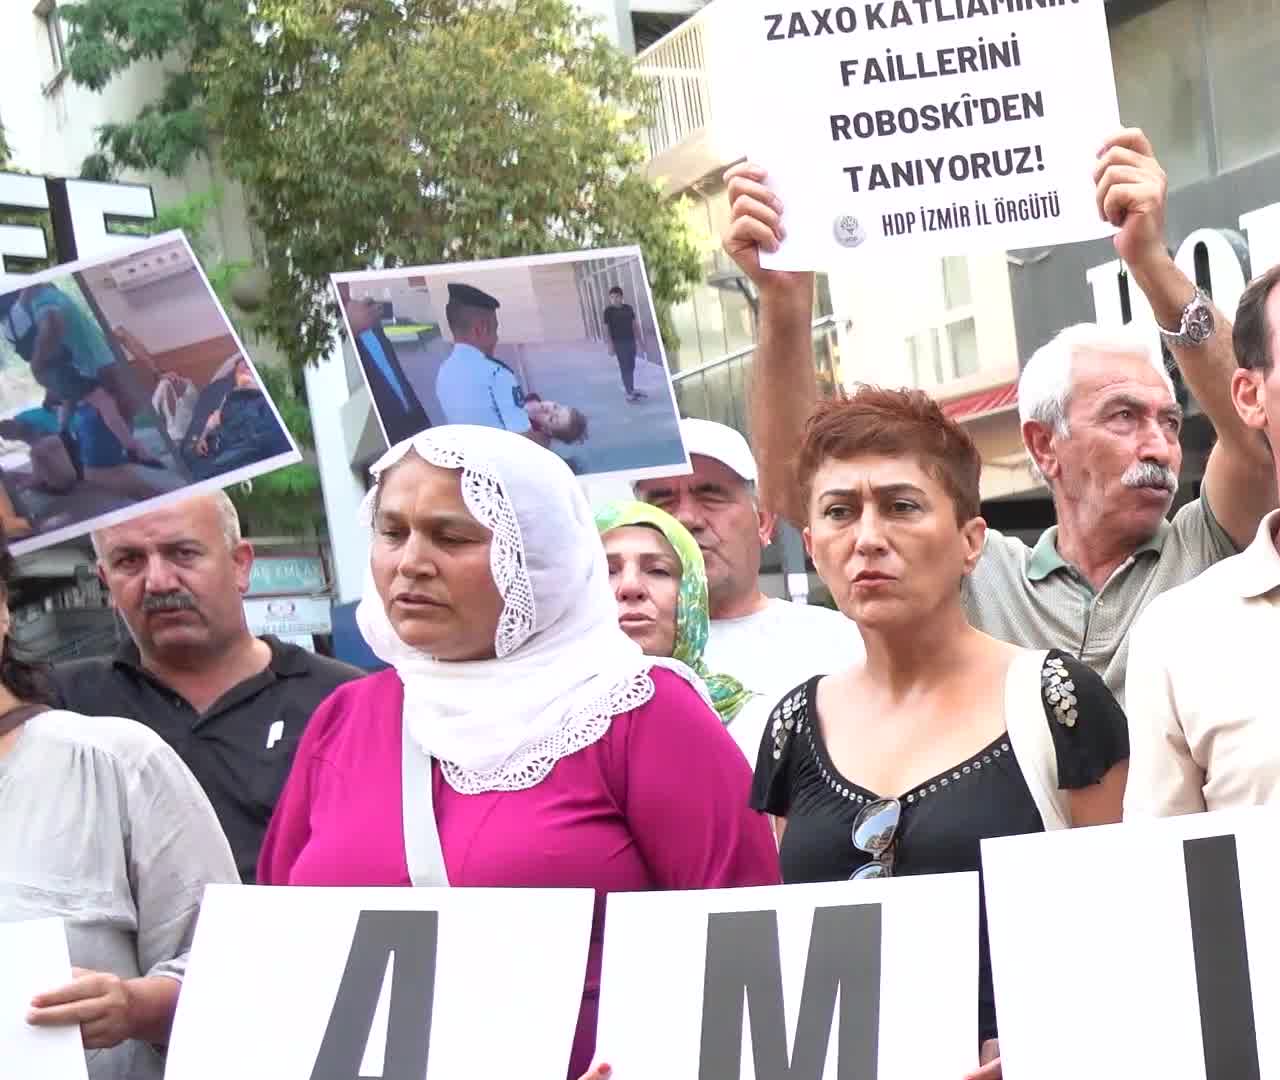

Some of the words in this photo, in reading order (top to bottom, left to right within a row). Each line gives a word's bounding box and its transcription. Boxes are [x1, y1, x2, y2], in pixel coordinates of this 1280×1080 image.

[764, 7, 857, 41] ZAXO
[840, 32, 1021, 87] FAİLLERİNİ
[843, 145, 1046, 193] TANIYORUZ!
[882, 211, 916, 237] HDP
[920, 202, 971, 232] İZMİR
[975, 199, 991, 227] İL
[994, 191, 1061, 224] ÖRGÜTÜ
